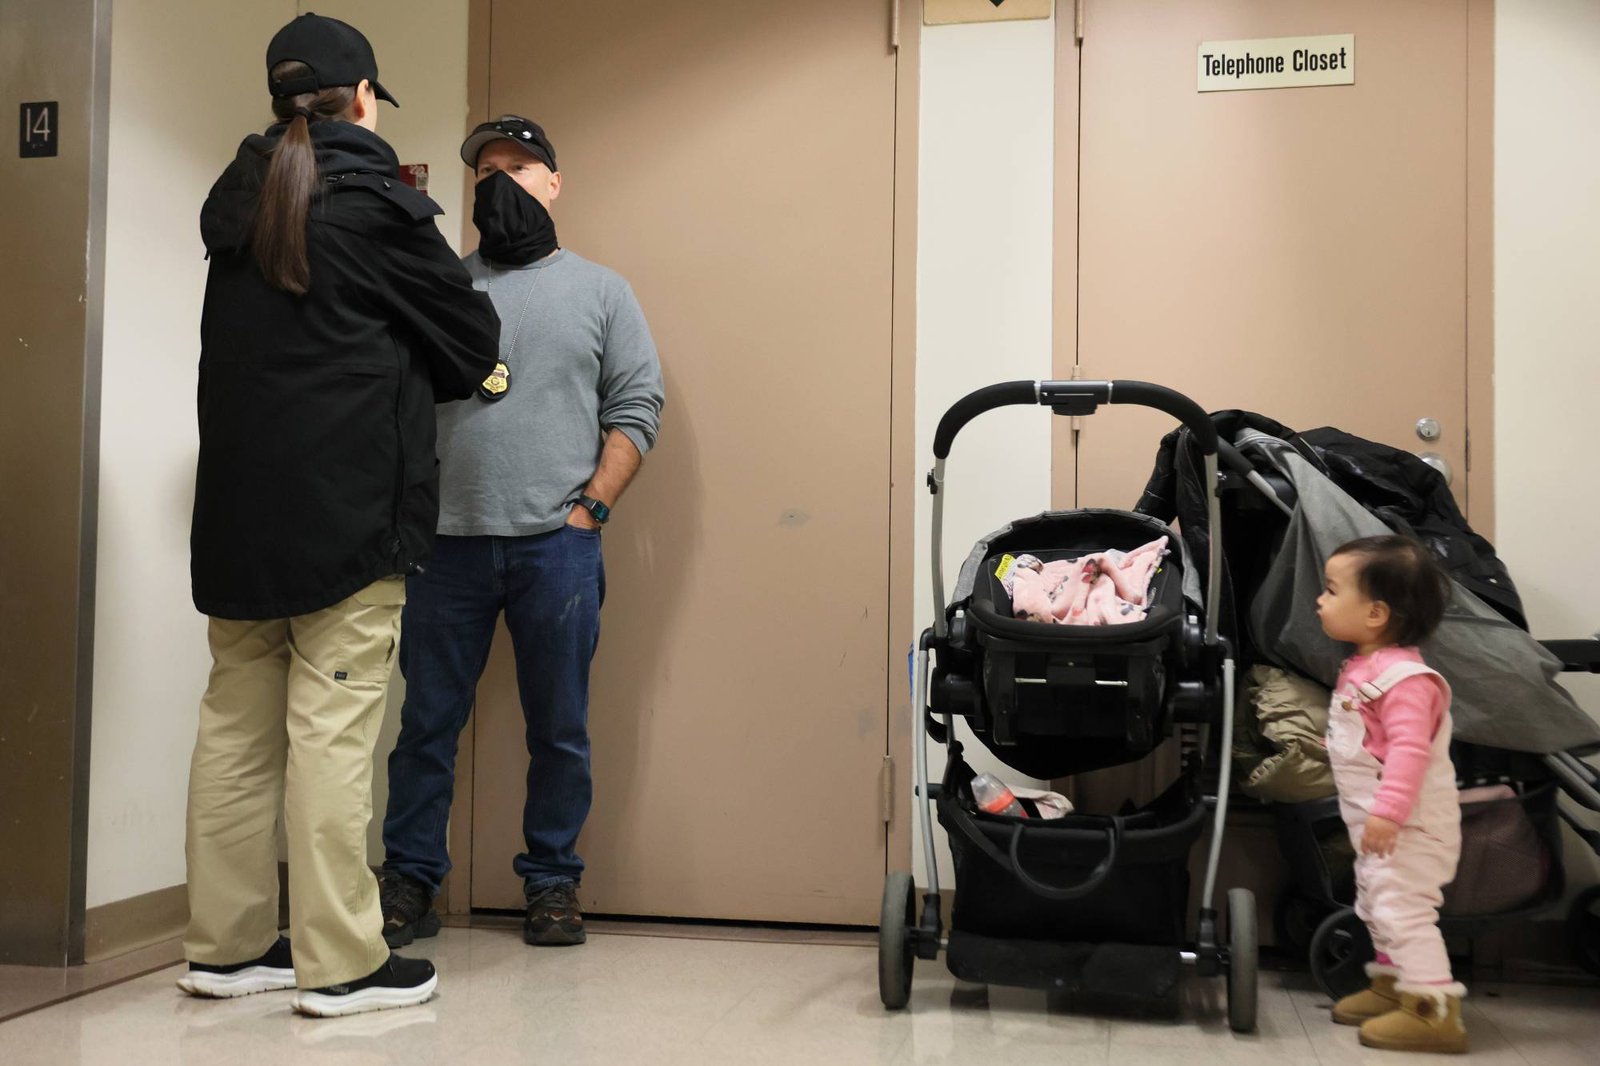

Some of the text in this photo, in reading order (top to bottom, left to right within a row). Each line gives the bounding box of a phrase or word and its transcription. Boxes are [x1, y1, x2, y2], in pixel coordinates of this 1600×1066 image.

[1203, 47, 1347, 79] Telephone Closet
[26, 107, 51, 142] 14
